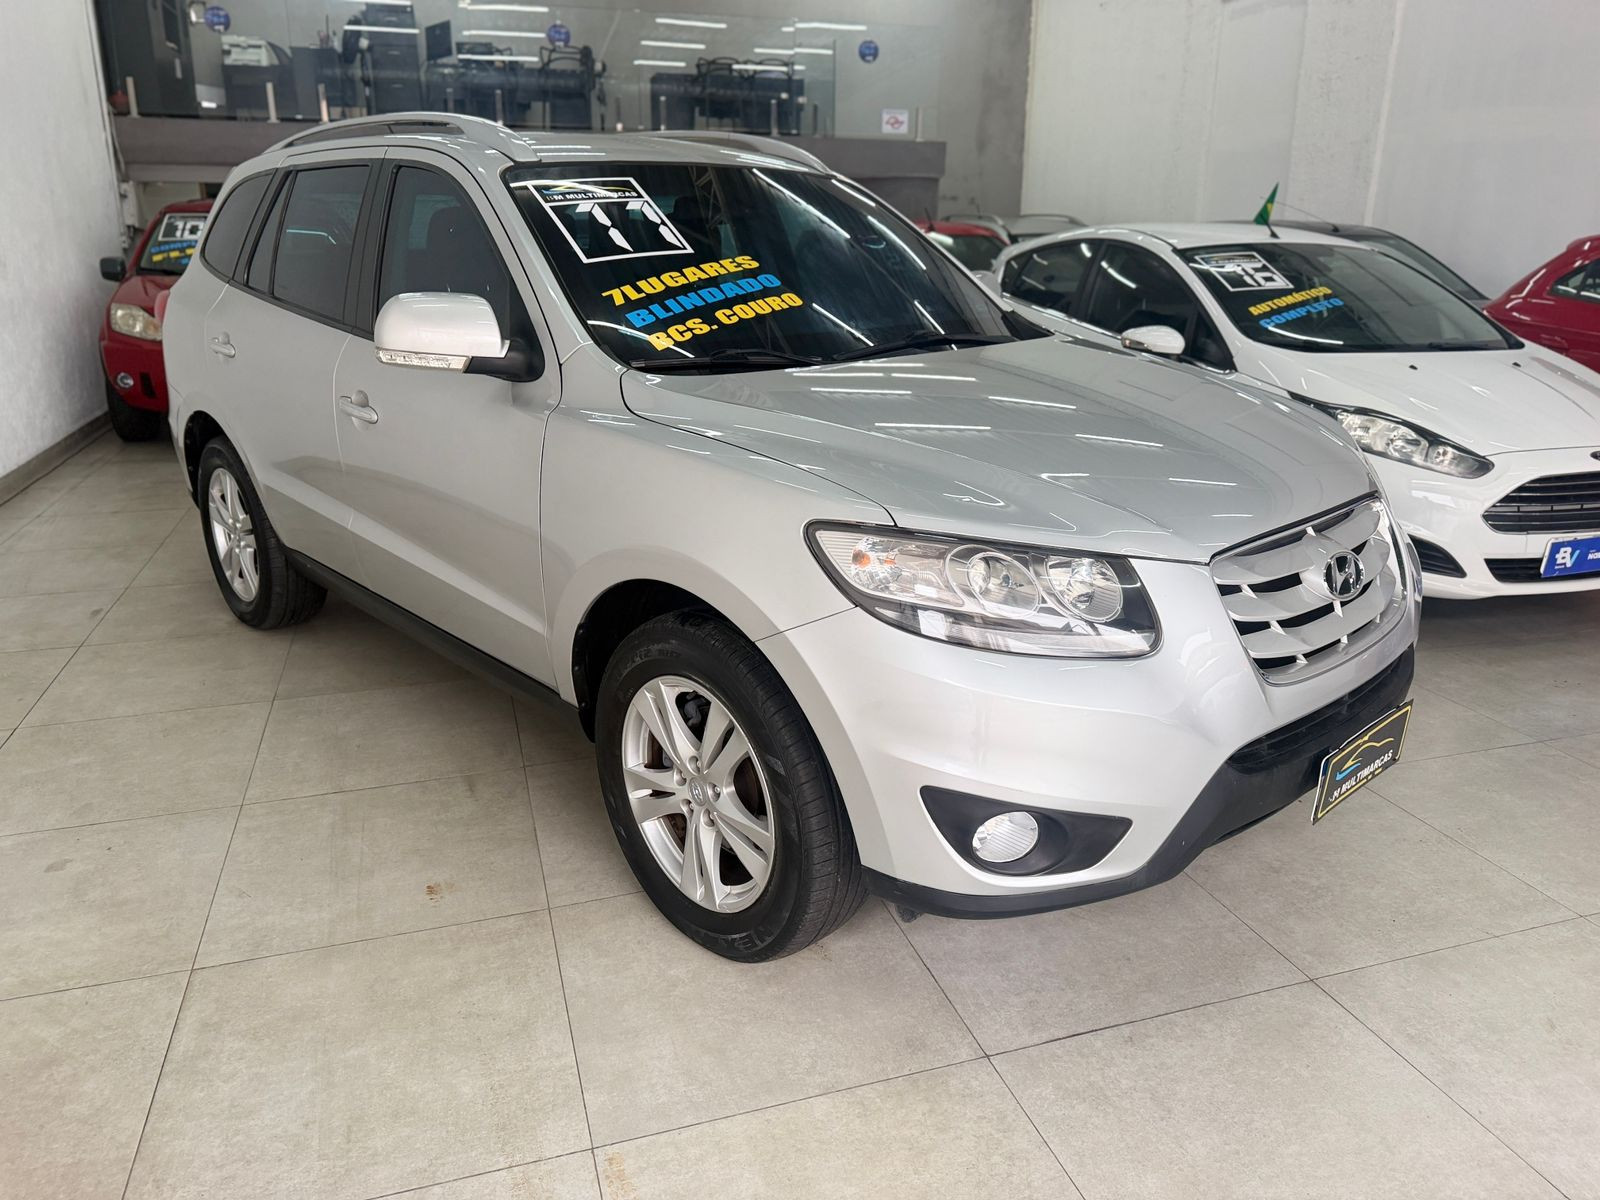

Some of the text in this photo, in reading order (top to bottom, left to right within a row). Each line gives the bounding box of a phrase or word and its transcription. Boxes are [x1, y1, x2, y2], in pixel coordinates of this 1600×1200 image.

[601, 255, 760, 306] 7LUGARES
[624, 273, 782, 328] BLINDADO
[1248, 286, 1332, 315] AUTOMÁTICO
[647, 292, 803, 351] BCS. COURO
[1259, 298, 1344, 328] COMPLETO
